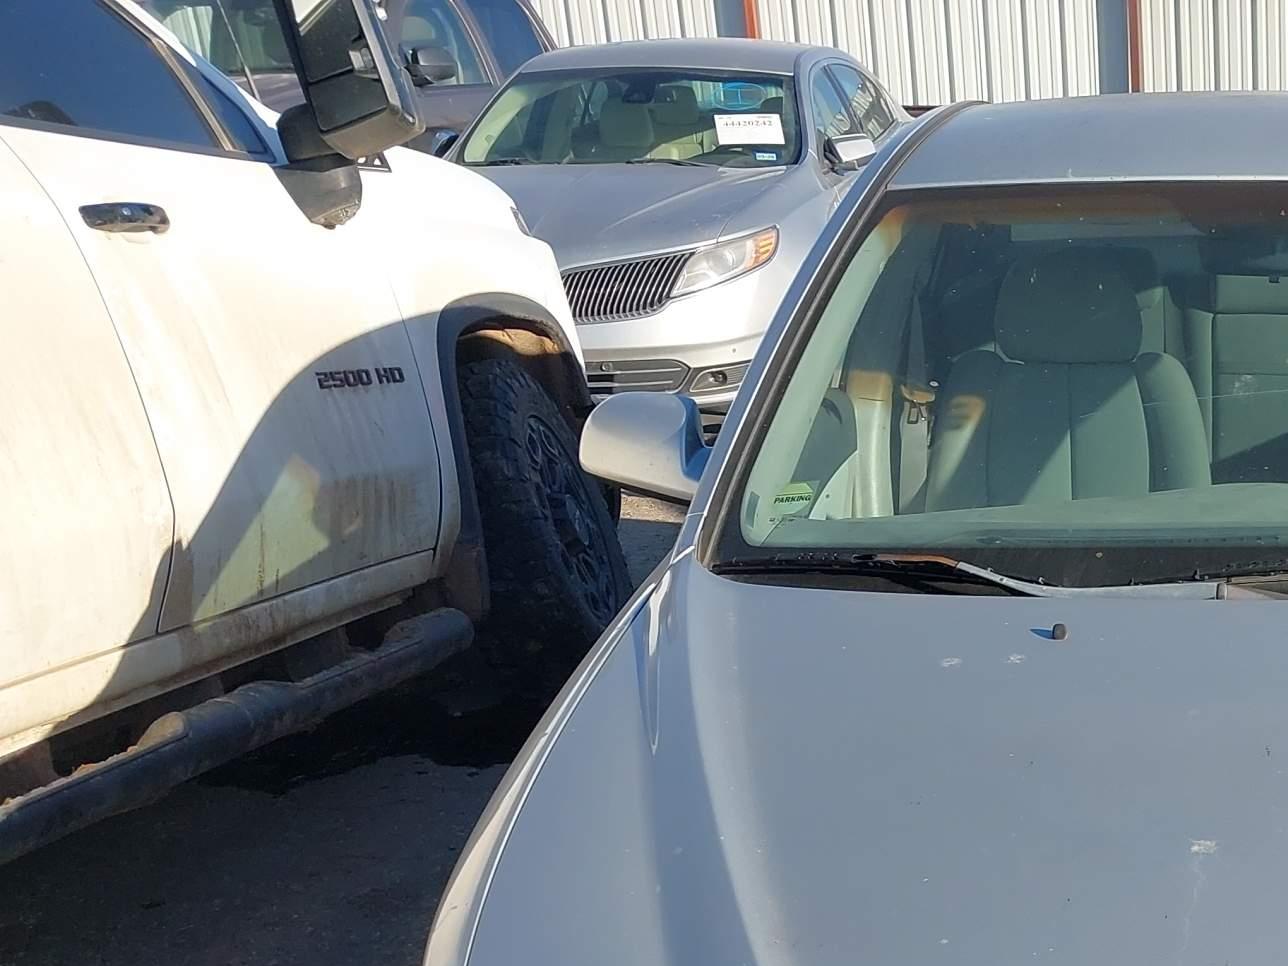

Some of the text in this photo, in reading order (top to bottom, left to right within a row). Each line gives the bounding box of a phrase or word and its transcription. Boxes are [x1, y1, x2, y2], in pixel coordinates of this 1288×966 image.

[315, 366, 406, 390] 2500 HD
[773, 494, 812, 505] PARKING
